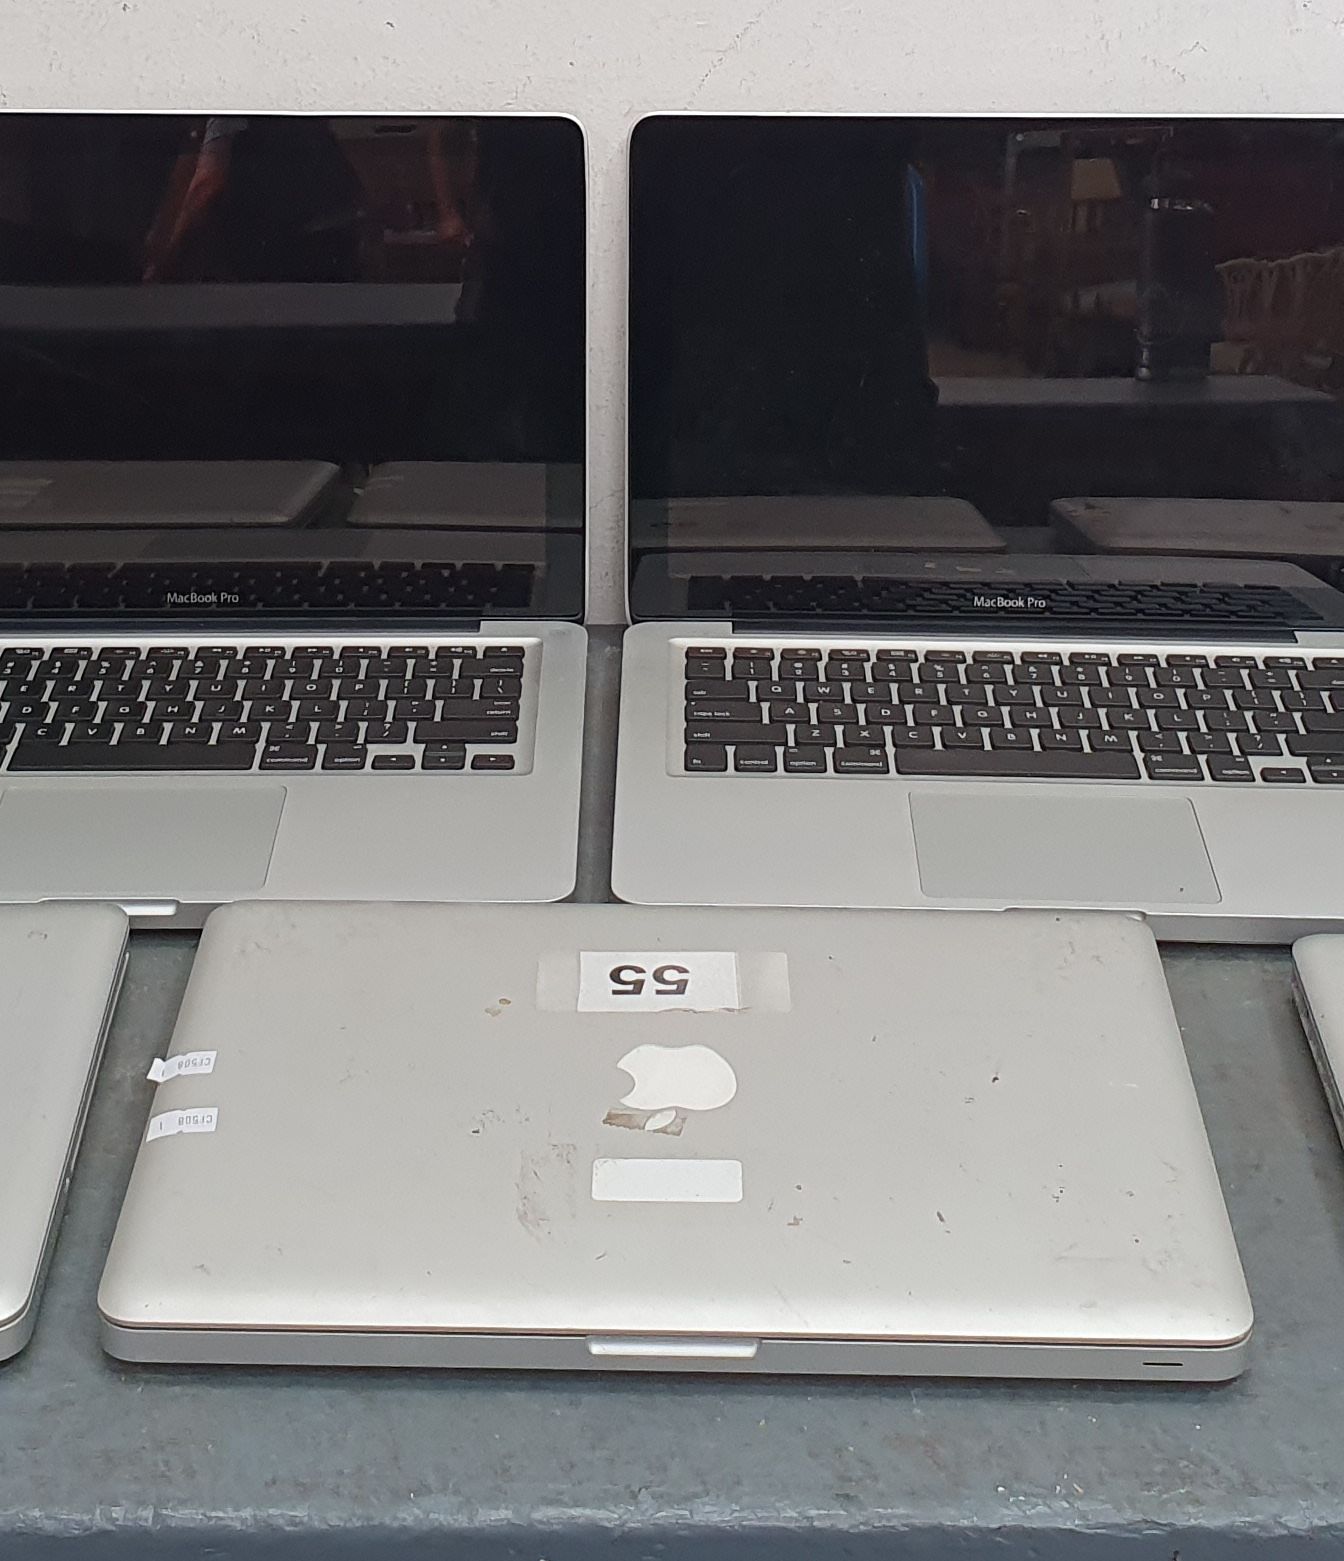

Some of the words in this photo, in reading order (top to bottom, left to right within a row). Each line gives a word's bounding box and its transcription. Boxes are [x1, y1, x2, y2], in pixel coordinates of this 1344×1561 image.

[166, 591, 218, 603] MacBook
[220, 592, 240, 603] Pro
[973, 596, 1025, 608] MacBook
[1027, 596, 1047, 608] Pro
[609, 964, 690, 995] 55
